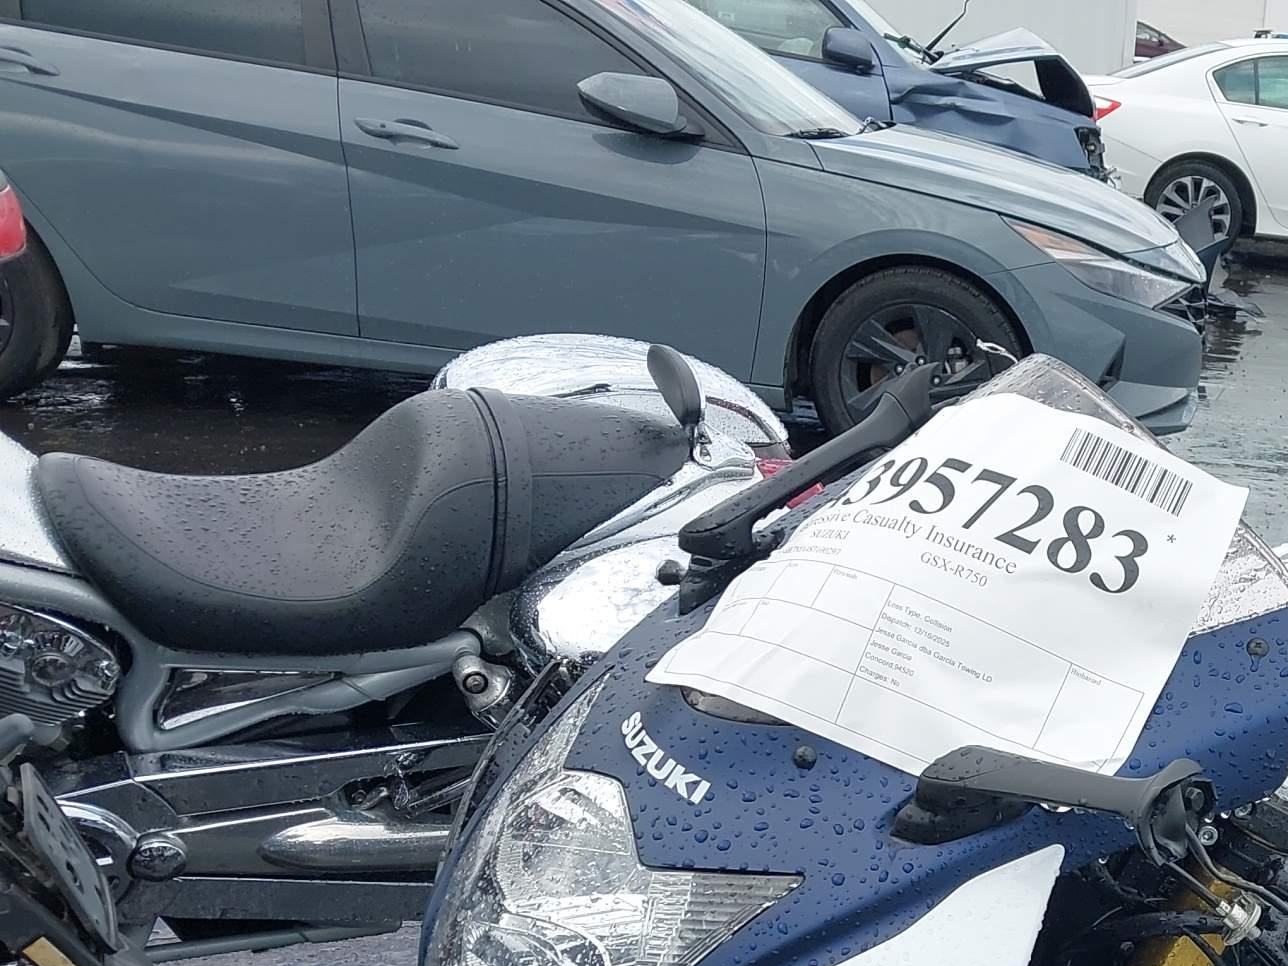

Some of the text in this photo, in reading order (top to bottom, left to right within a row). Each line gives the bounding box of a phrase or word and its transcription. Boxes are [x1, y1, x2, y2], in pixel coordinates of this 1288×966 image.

[831, 456, 1149, 593] 3957283
[852, 508, 923, 539] Casualty
[925, 525, 1017, 574] Insurance
[920, 552, 988, 587] GSX-R750
[957, 662, 981, 679] Towing
[621, 711, 711, 805] SUZUKI
